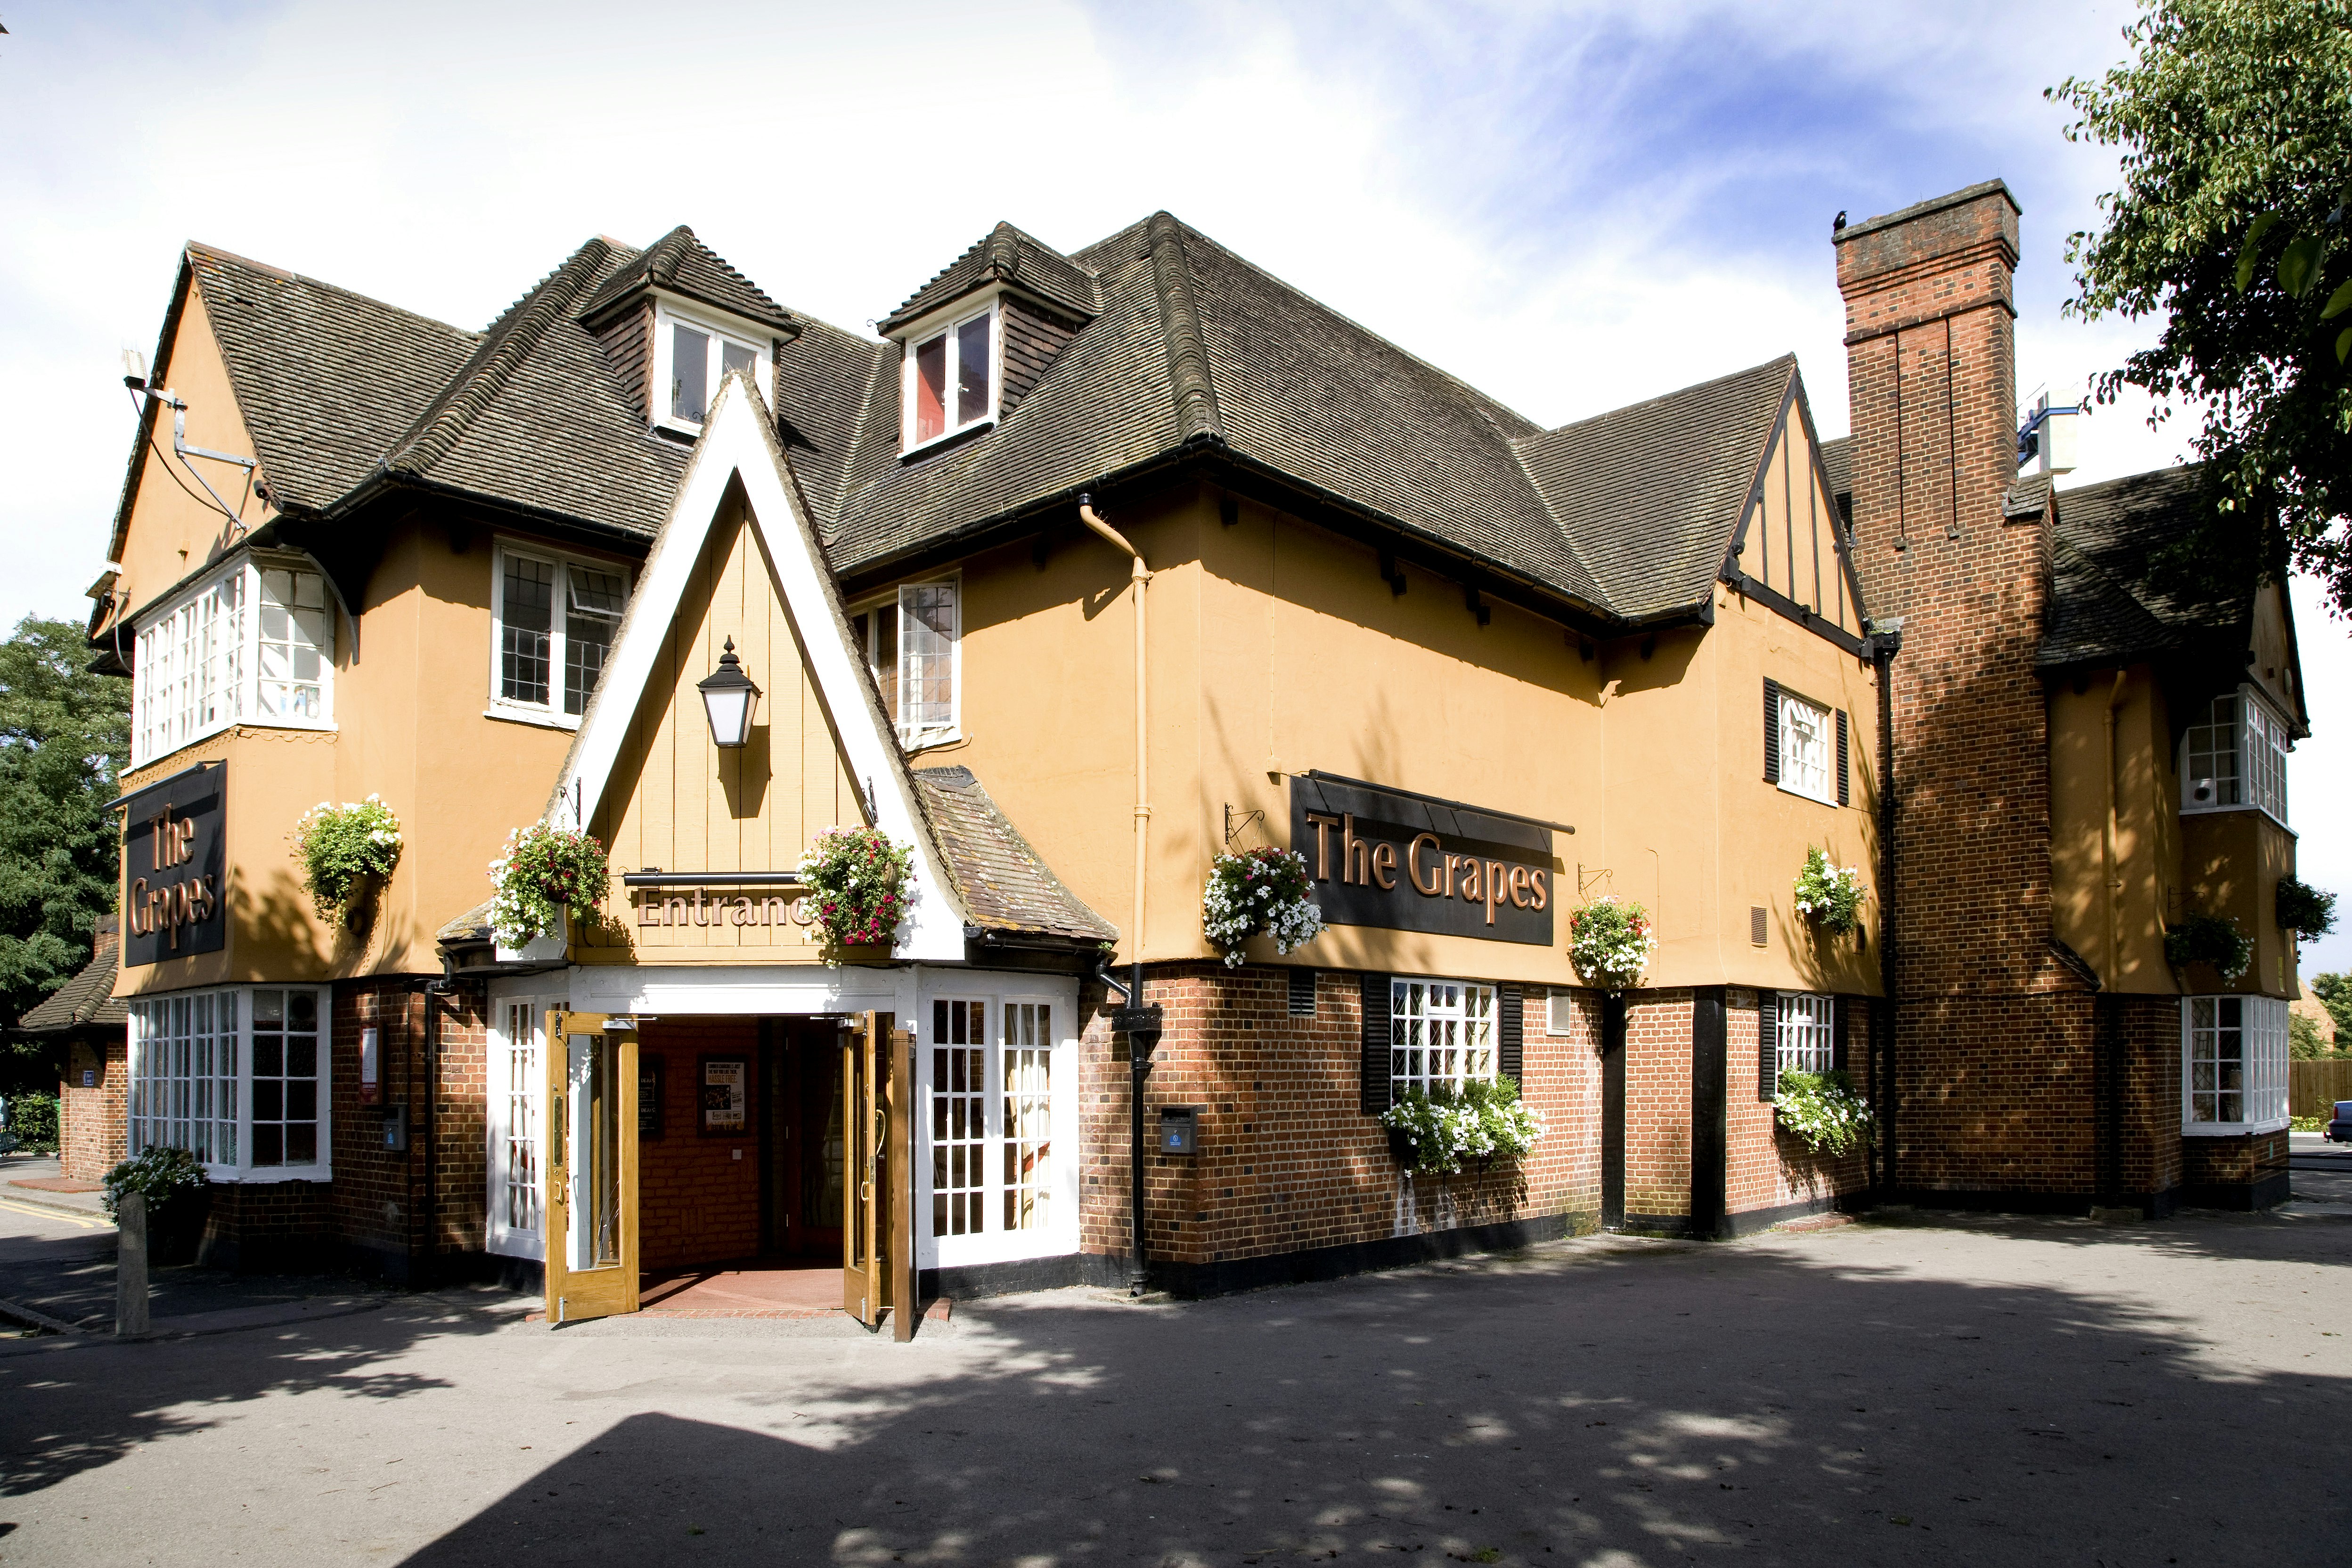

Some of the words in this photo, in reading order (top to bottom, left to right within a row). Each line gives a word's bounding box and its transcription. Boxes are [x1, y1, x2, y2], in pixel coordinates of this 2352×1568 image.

[149, 802, 194, 872] The
[1307, 811, 1397, 890] The
[1408, 833, 1547, 924] Grapes
[130, 874, 215, 950] Grapes
[638, 886, 827, 927] Entranc
[708, 1075, 725, 1083] HASSLE
